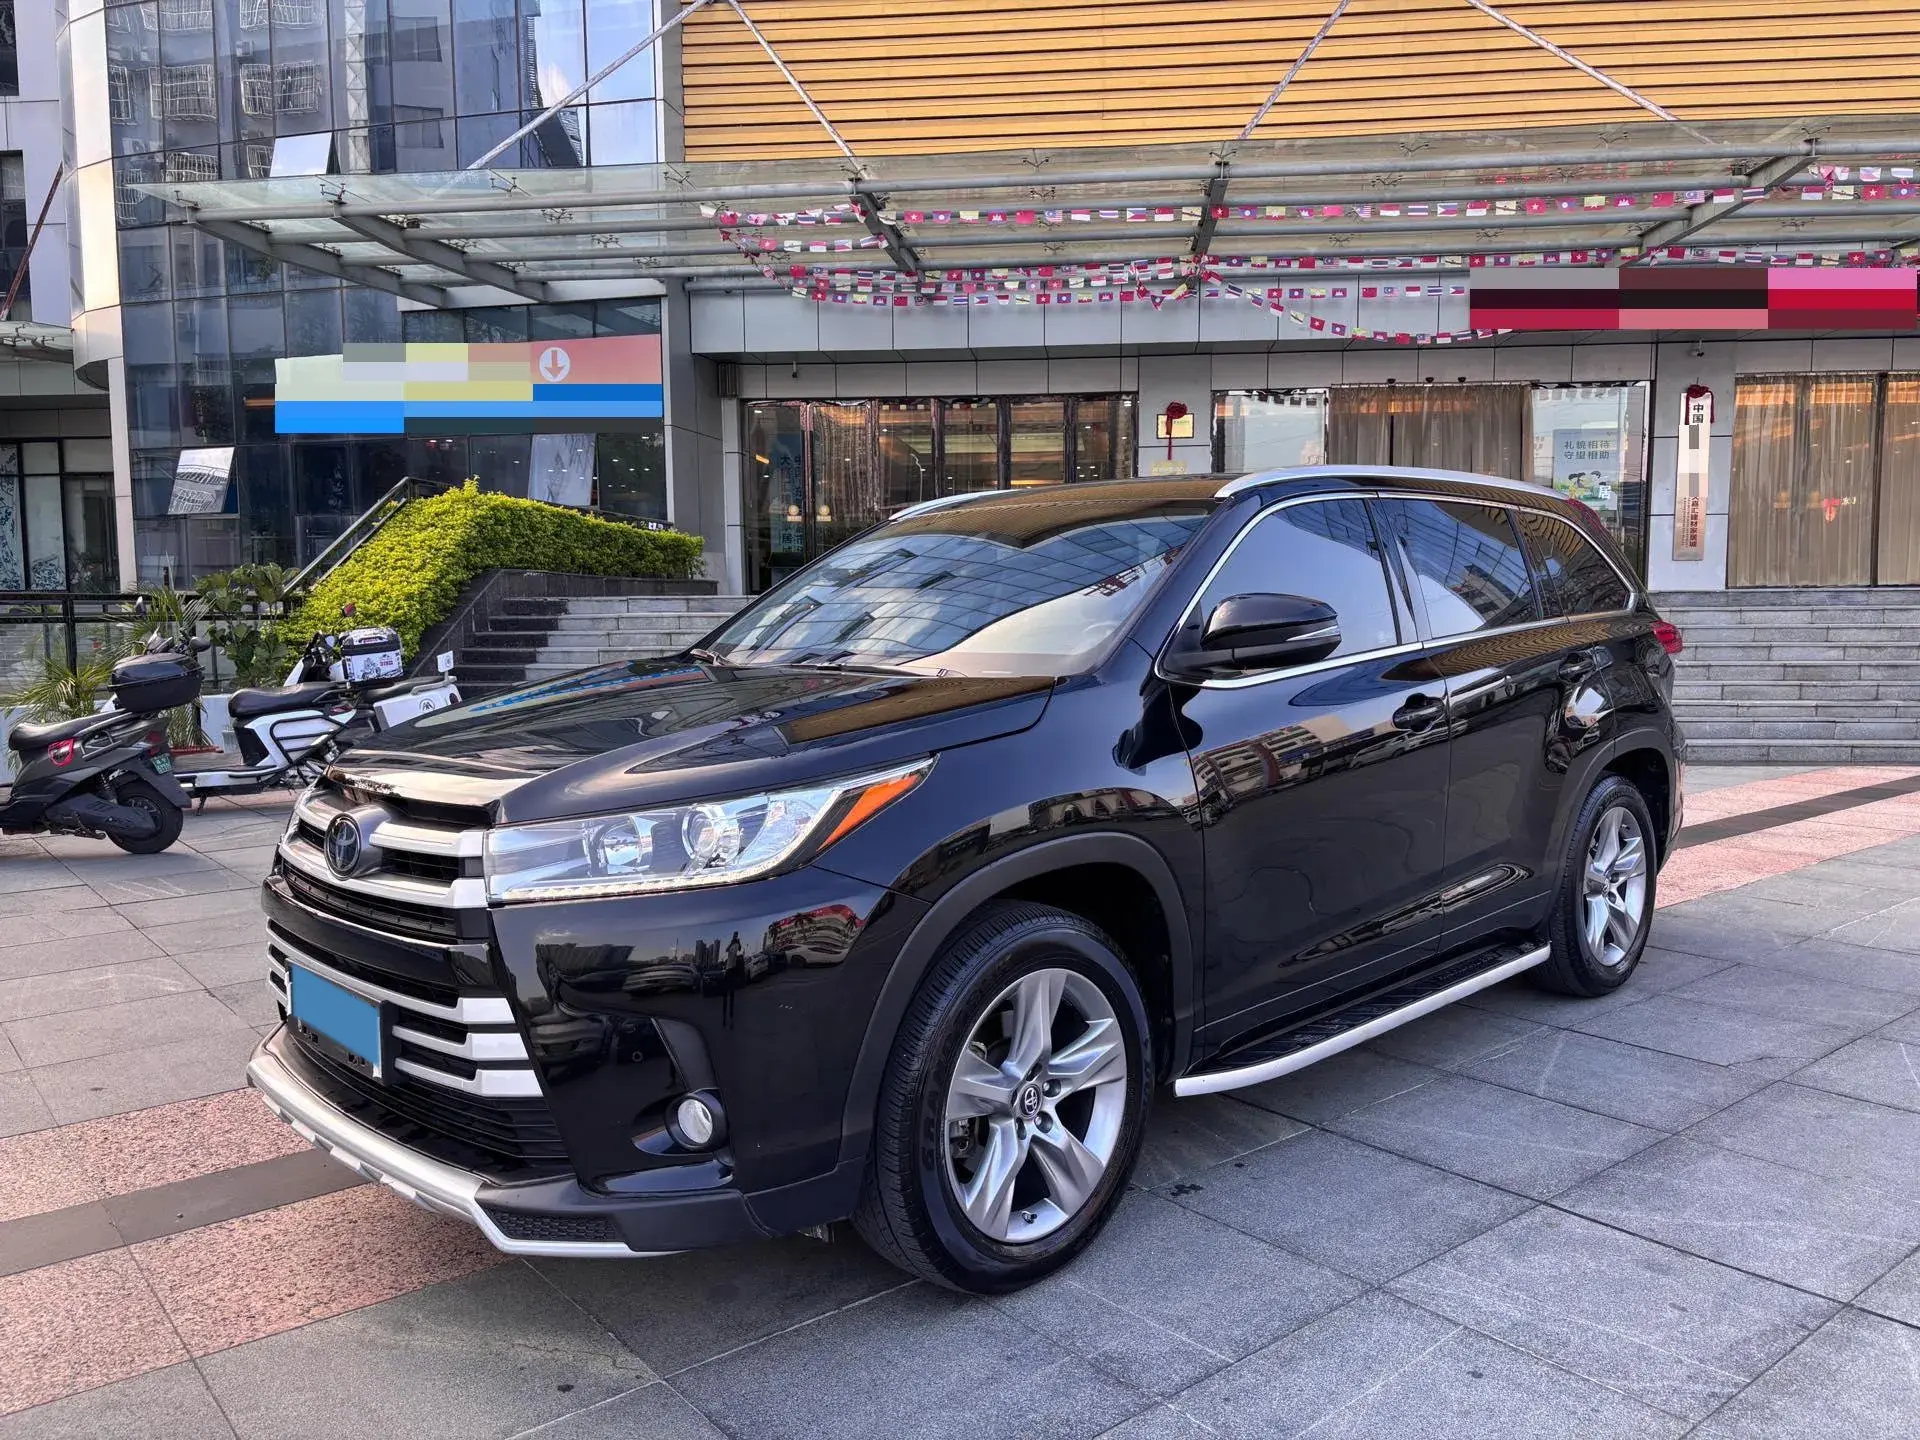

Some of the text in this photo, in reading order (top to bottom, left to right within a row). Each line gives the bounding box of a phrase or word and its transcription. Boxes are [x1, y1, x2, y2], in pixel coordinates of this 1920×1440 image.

[1693, 403, 1704, 424] 中国
[1564, 440, 1611, 450] 礼貌相待
[1564, 451, 1610, 460] 守望相助
